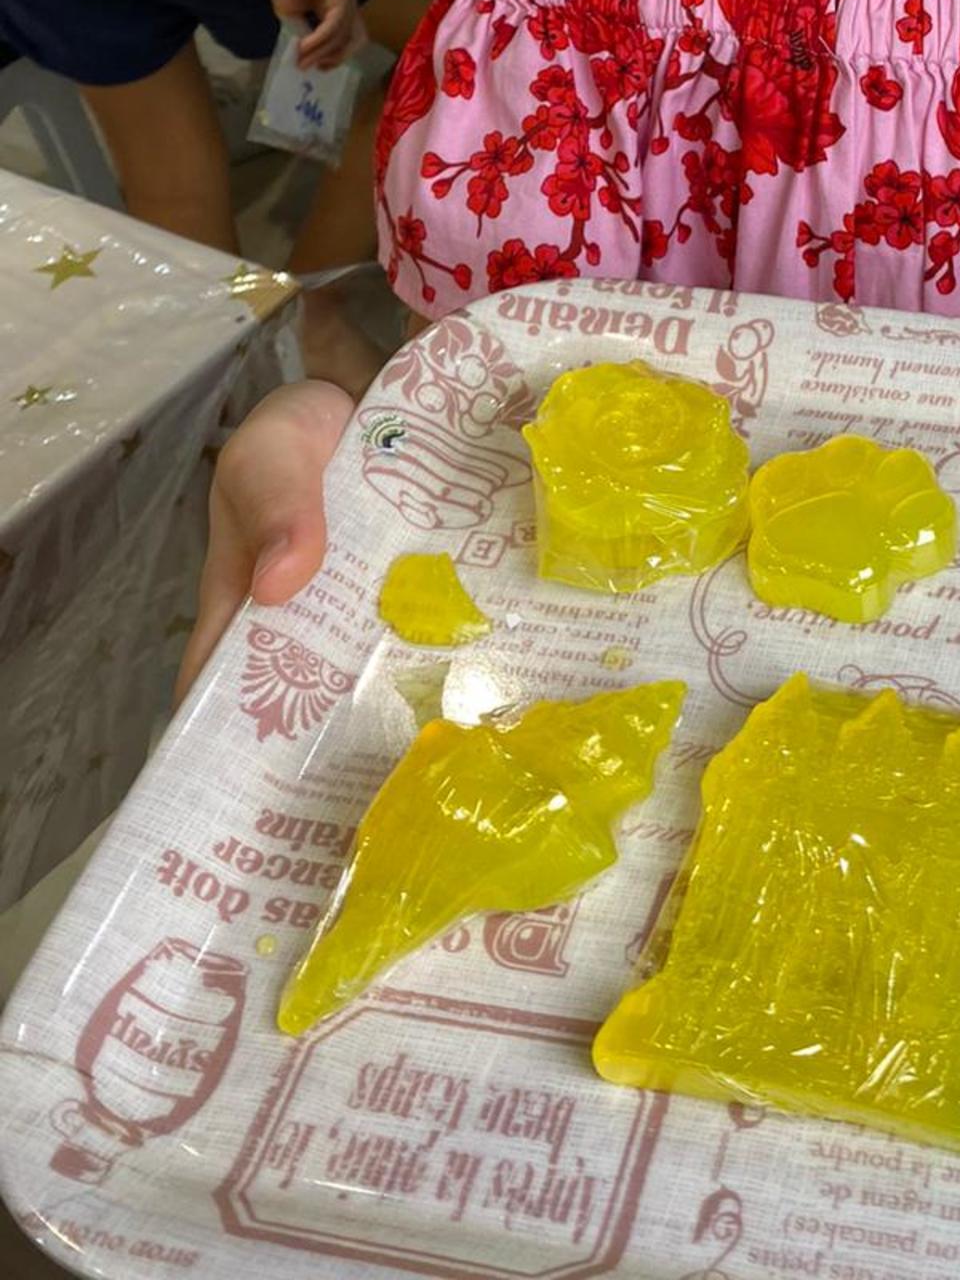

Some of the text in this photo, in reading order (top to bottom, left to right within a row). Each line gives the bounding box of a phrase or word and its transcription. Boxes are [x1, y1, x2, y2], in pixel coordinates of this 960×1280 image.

[495, 291, 696, 358] Demain
[804, 349, 886, 385] humide.
[798, 379, 912, 408] consistance
[918, 393, 954, 409] une
[792, 407, 864, 432] donner
[869, 416, 894, 435] de
[344, 551, 370, 572] ou
[321, 566, 368, 602] beur
[282, 602, 328, 627] peti
[304, 584, 377, 633] d'érabl
[526, 598, 650, 630] d'arachide,
[328, 624, 352, 645] au
[564, 625, 641, 652] beurre,
[845, 614, 941, 646] pour
[211, 835, 344, 890] encer
[155, 848, 251, 926] doit
[345, 1053, 578, 1166] beau temps
[263, 1122, 317, 1192] le
[809, 1142, 904, 1173] poudre
[434, 1150, 482, 1224] la
[910, 1161, 931, 1189] la
[480, 1156, 595, 1246] Après
[818, 1181, 852, 1210] de
[860, 1189, 932, 1214] agent
[782, 1214, 918, 1257] pancakes)
[925, 1240, 959, 1262] ou
